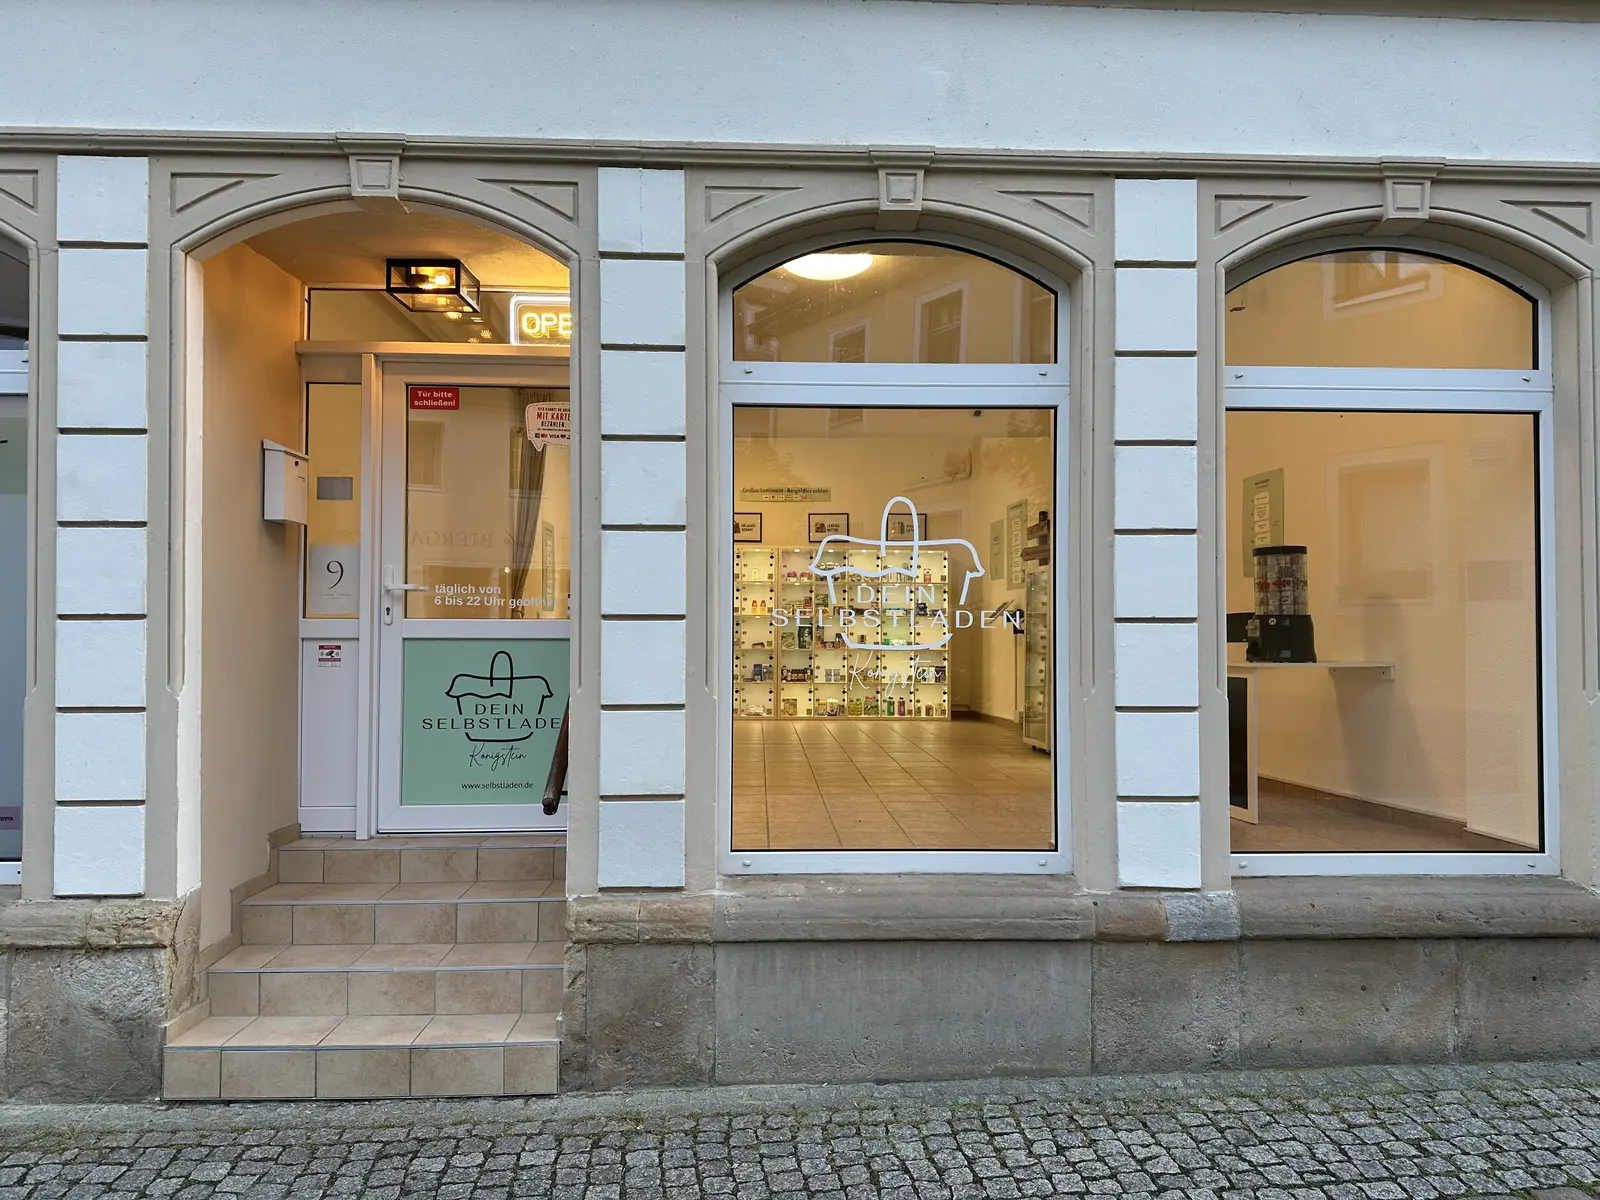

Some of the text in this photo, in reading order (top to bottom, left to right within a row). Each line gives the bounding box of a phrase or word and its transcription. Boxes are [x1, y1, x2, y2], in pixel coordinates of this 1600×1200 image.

[522, 313, 571, 335] OPE
[416, 390, 431, 398] Tür
[414, 399, 456, 407] schließen!
[536, 412, 548, 420] MIT
[326, 560, 344, 590] 9
[435, 584, 501, 596] täglich von
[857, 585, 935, 604] DEIN
[434, 596, 442, 606] 6
[445, 596, 463, 606] bis
[466, 596, 481, 606] 22
[484, 597, 506, 606] Uhr
[771, 608, 1021, 629] SELBSTLADEN
[475, 703, 524, 715] DEIN
[422, 717, 560, 730] SELBSTLADE
[461, 781, 534, 789] www.selbstladen.de
